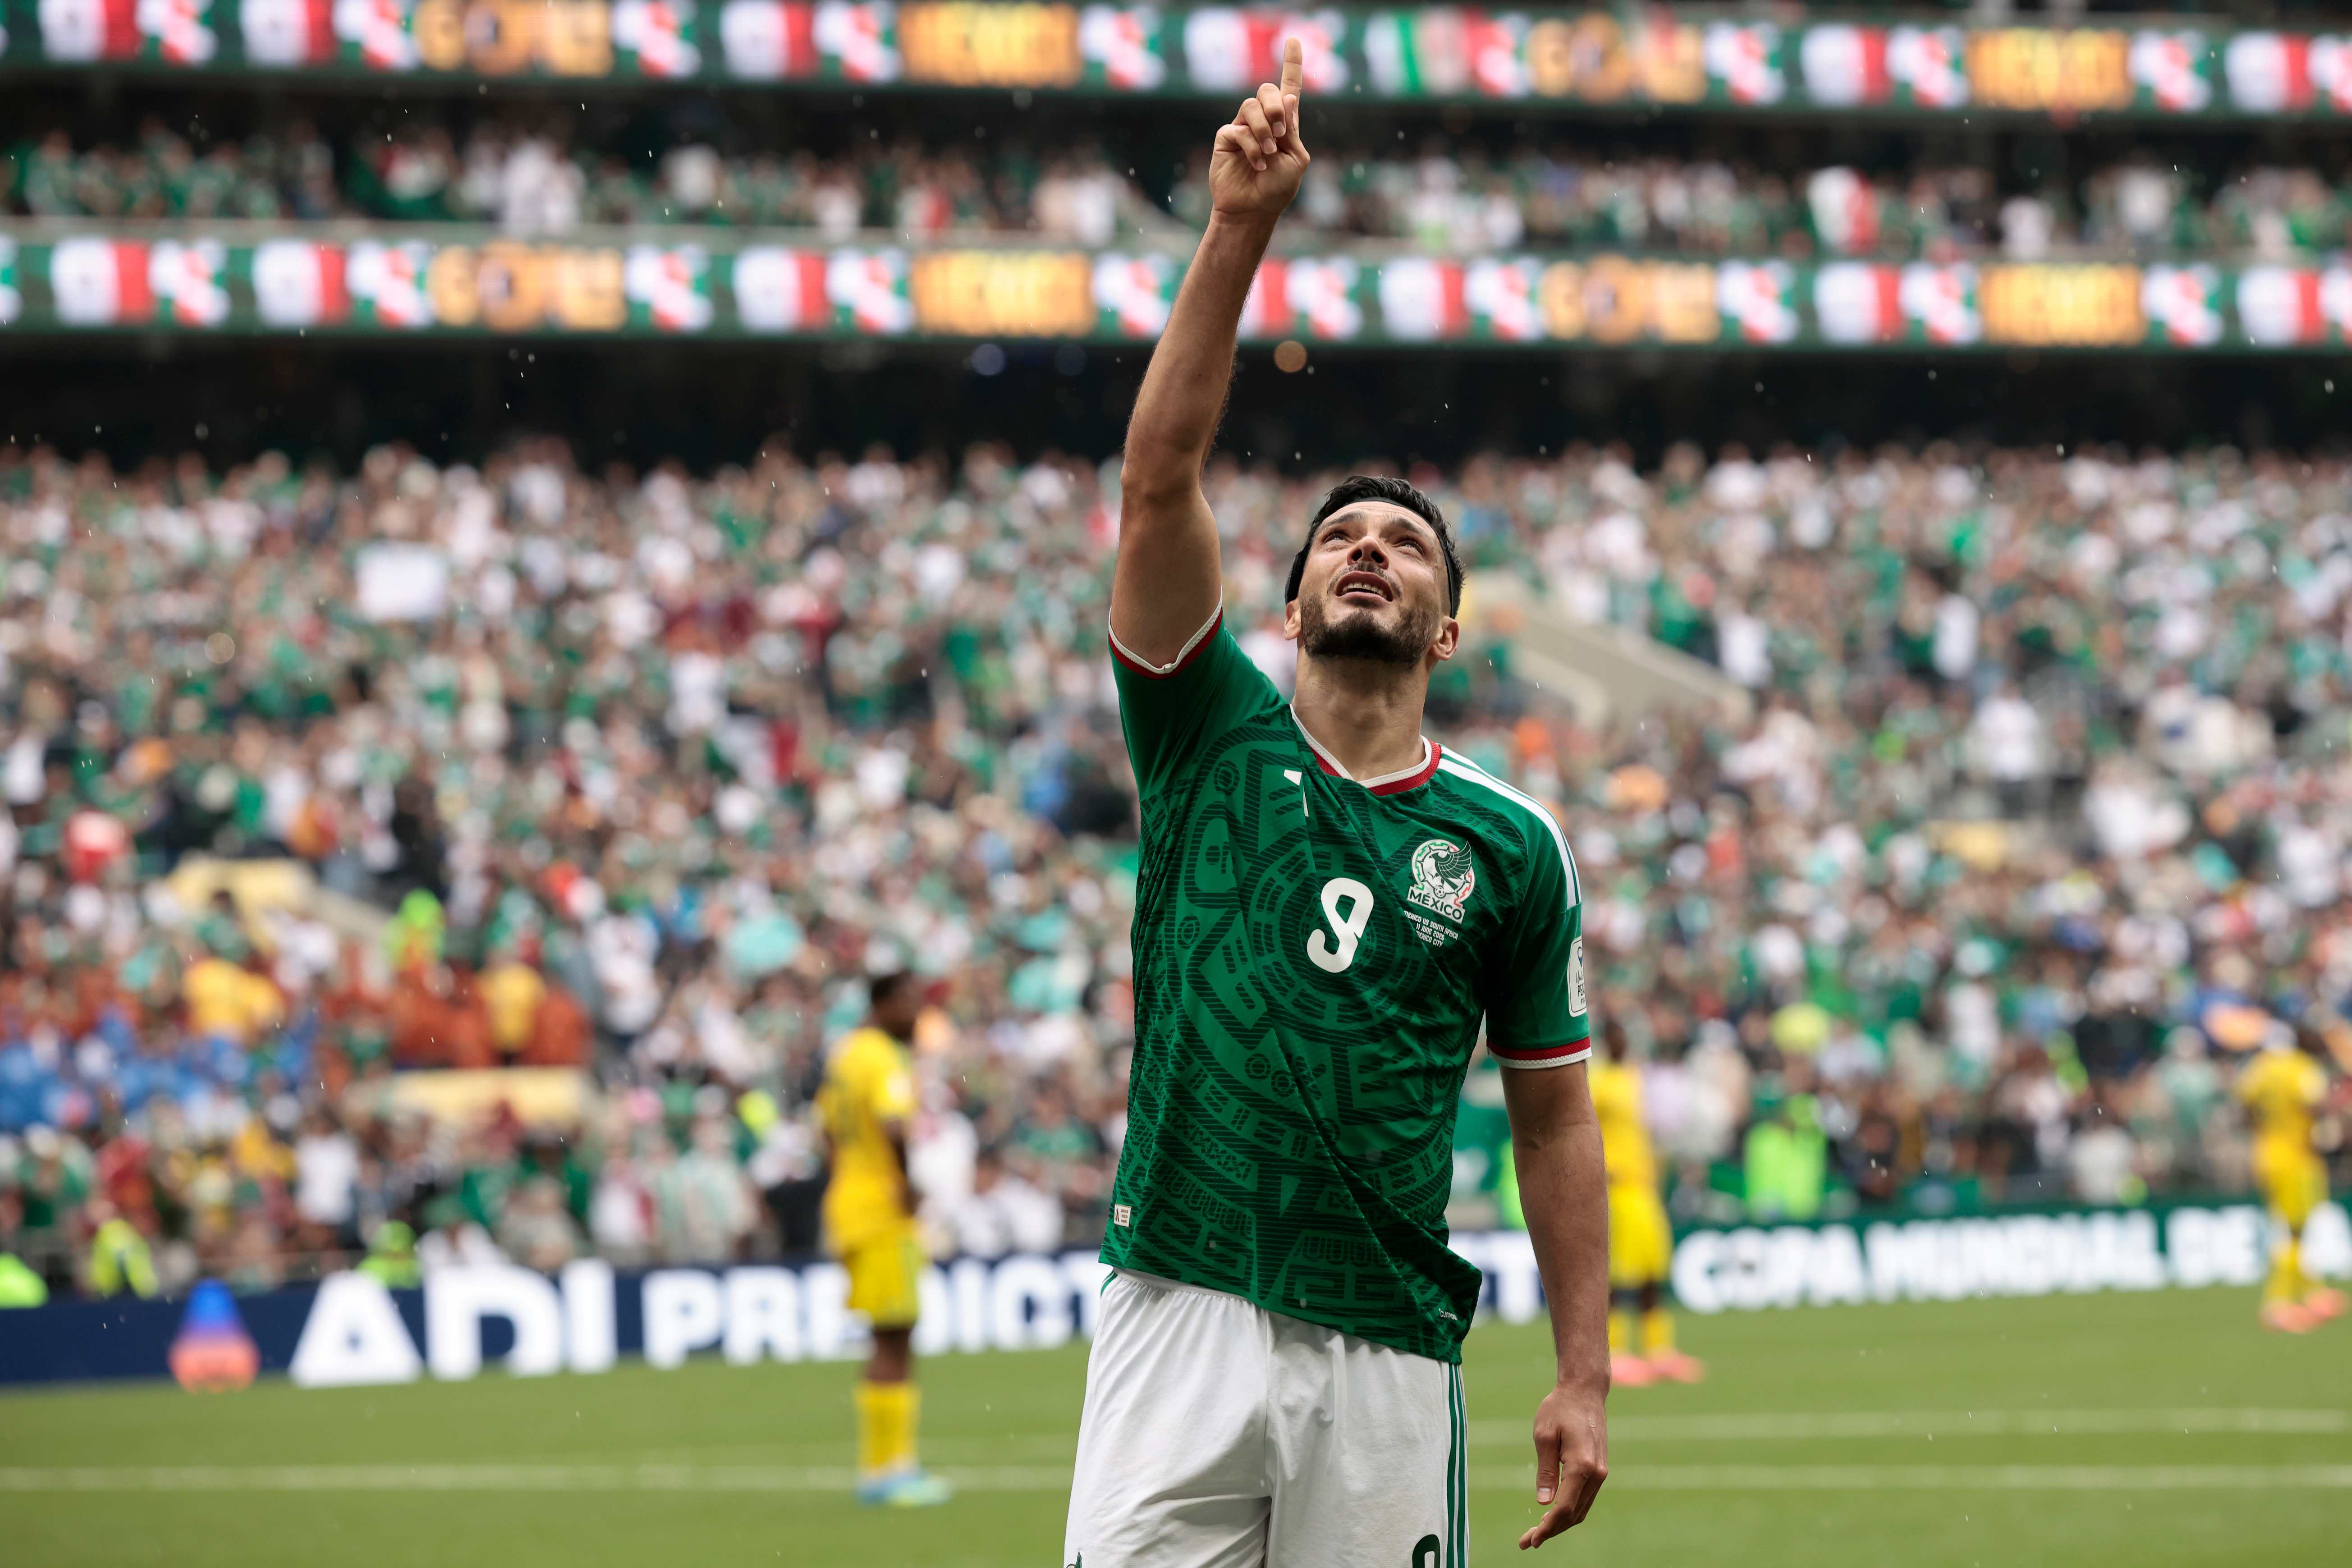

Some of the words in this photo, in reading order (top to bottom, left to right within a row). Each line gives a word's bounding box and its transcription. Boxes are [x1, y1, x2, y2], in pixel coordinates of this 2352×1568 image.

[1409, 889, 1463, 920] MÉXICO
[1307, 877, 1374, 973] 9
[1421, 925, 1432, 935] JUNE
[1433, 930, 1445, 941] 2026
[1430, 921, 1444, 932] SOUTH
[1444, 928, 1458, 940] AFRICA
[1433, 938, 1443, 948] CITY
[1672, 1224, 1866, 1314] COPA
[1864, 1209, 2164, 1303] MUNDIAL
[288, 1257, 619, 1389] ADI
